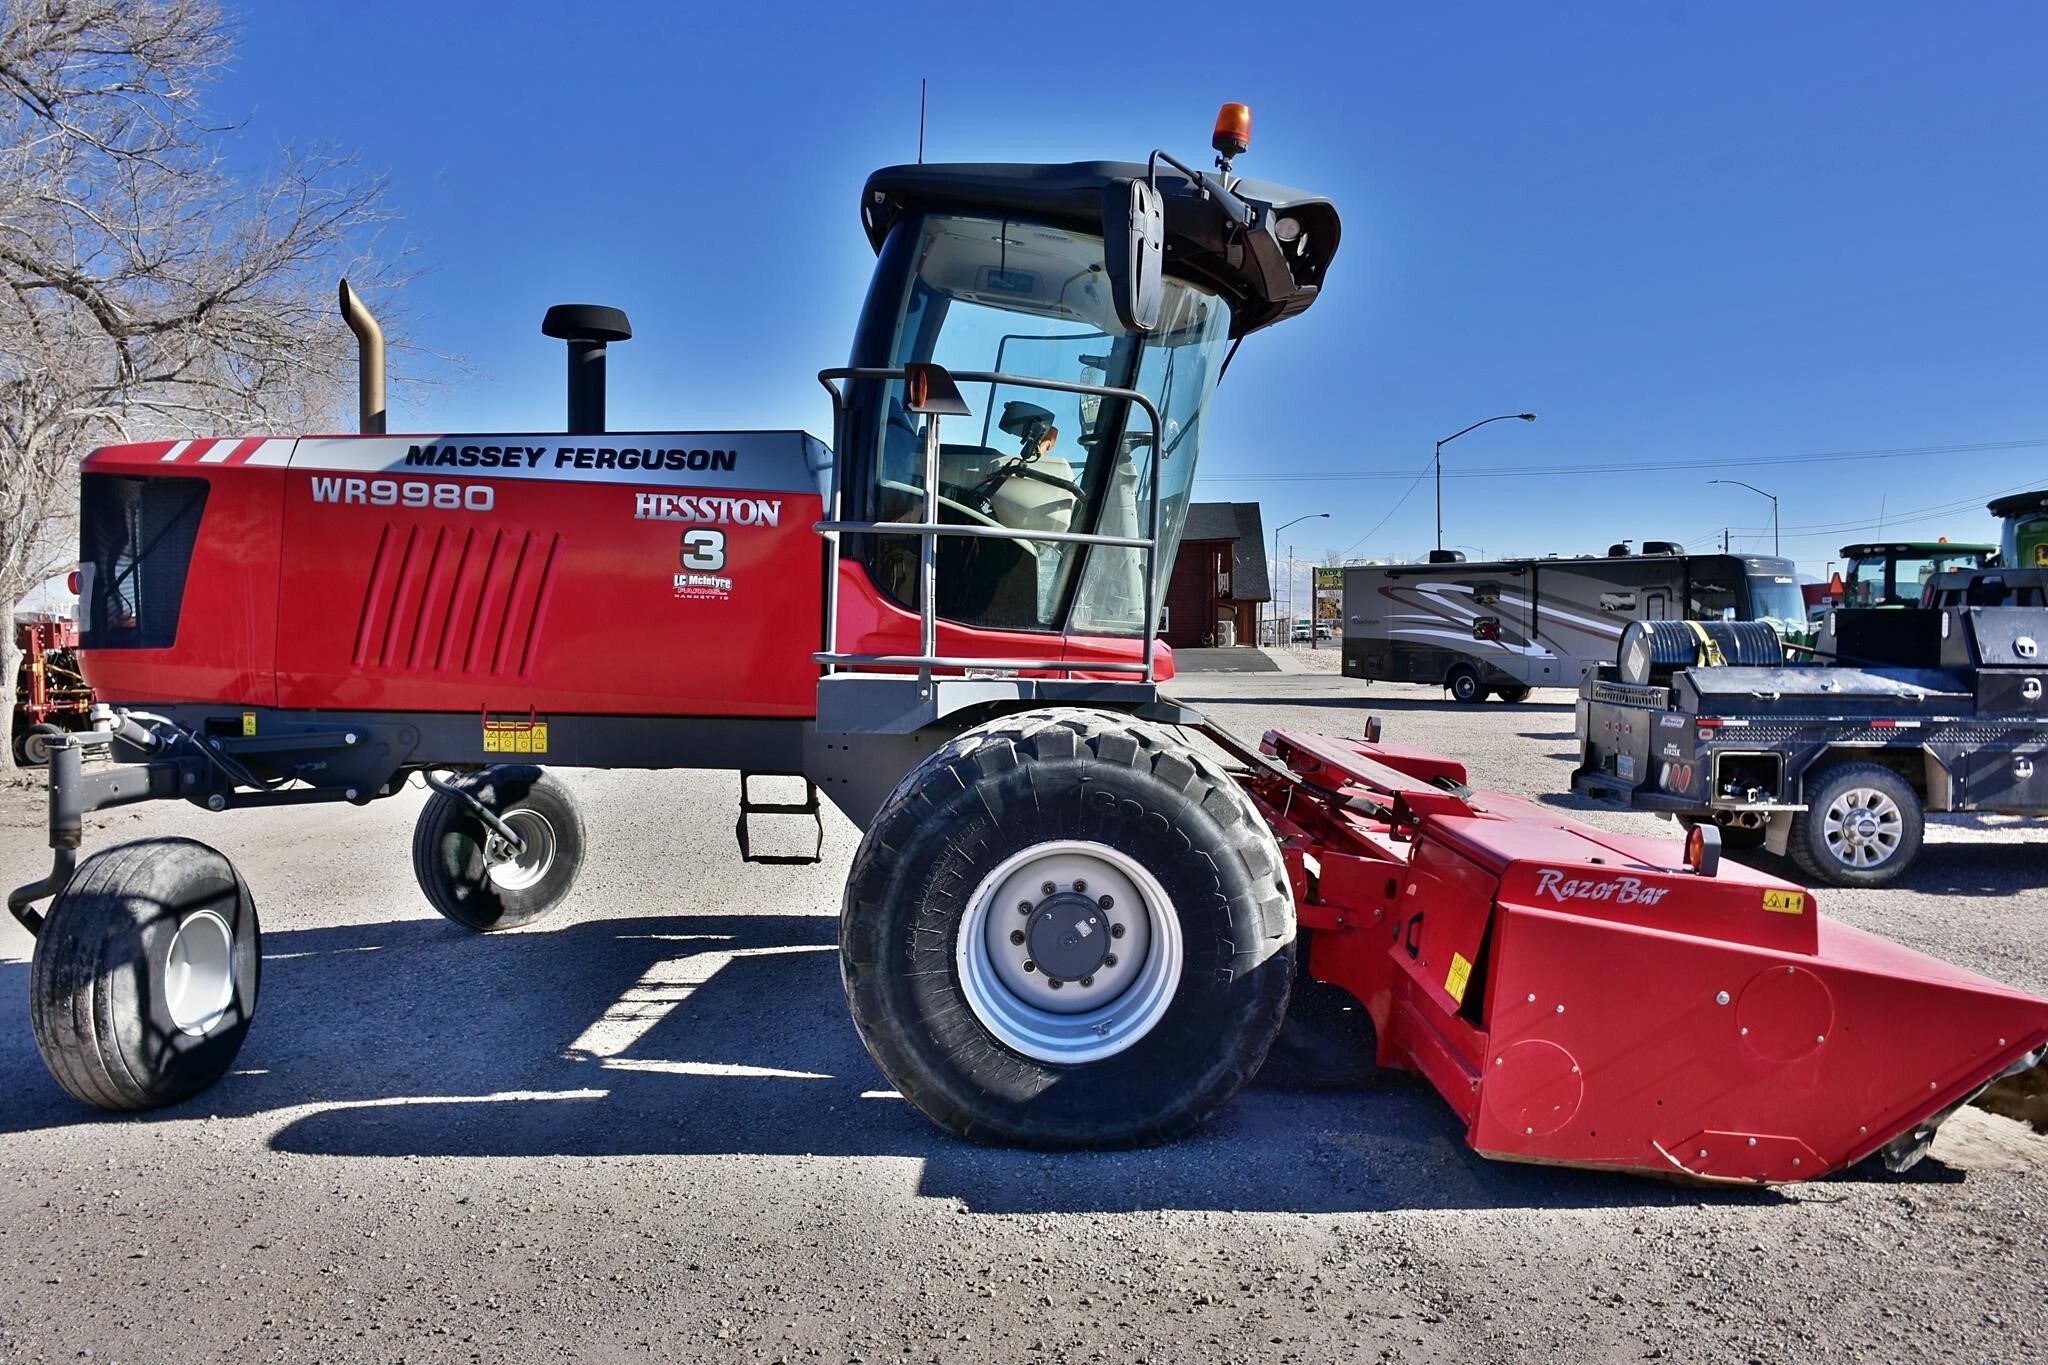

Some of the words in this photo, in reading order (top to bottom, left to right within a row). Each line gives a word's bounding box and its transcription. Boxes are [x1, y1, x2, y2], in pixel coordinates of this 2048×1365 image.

[404, 444, 545, 469] MASSEY
[553, 446, 737, 472] FERGUSON
[310, 476, 495, 512] WR9980
[634, 493, 782, 527] HESSTON
[680, 526, 727, 571] 3
[674, 574, 687, 587] LC
[688, 575, 731, 589] McIntyre
